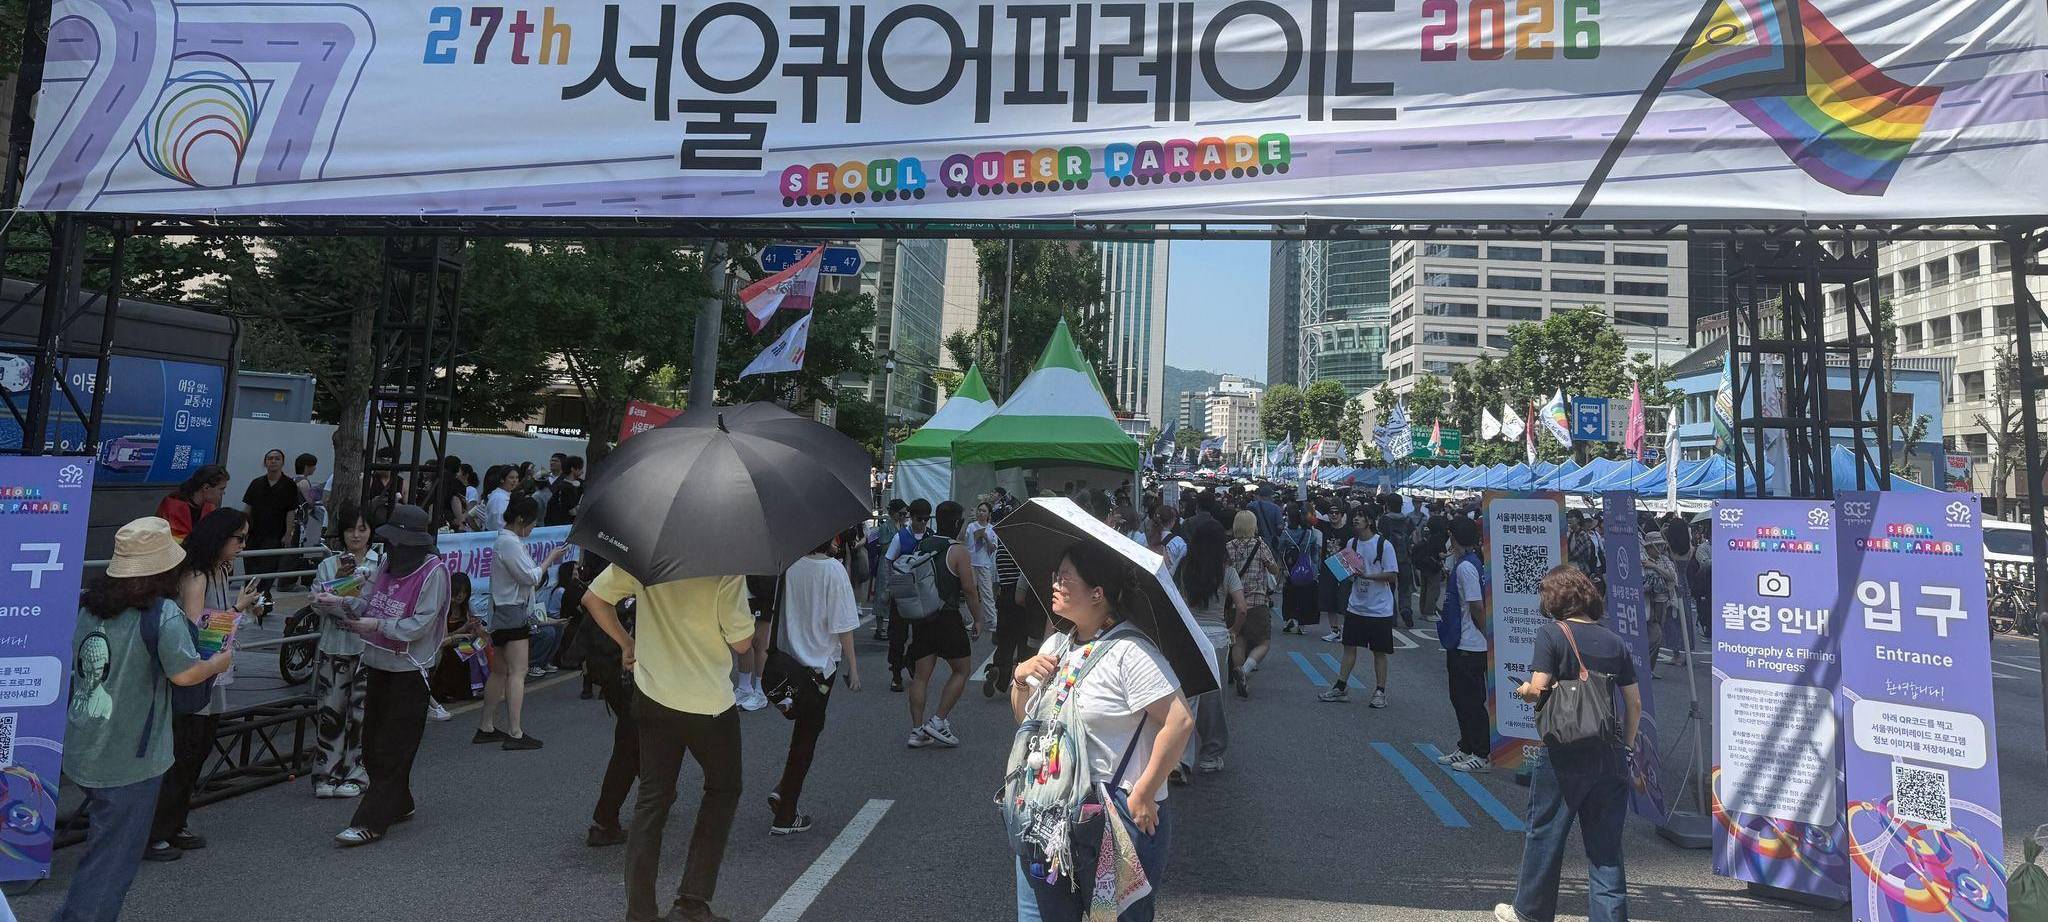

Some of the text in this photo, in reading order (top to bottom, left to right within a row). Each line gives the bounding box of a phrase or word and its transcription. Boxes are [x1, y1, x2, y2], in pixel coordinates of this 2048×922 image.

[424, 5, 572, 65] 27th
[1420, 0, 1601, 62] 2026
[561, 1, 1398, 171] 서울퀴어퍼레이드
[785, 137, 1284, 195] SEOUL QUEER PARADE
[765, 253, 777, 264] 41
[843, 257, 857, 268] 47
[178, 379, 196, 393] 여유
[12, 502, 69, 512] PARADE
[1518, 525, 1547, 535] 만들어요
[1757, 527, 1796, 537] SEOUL
[1887, 524, 1933, 536] SEOUL
[1728, 539, 1821, 552] QUEER PARADE
[1856, 538, 1962, 553] QUEER PARADE
[1617, 602, 1640, 637] 금연
[1721, 602, 1830, 637] 촬영 안내
[1718, 641, 1836, 664] Photography & Filming
[1875, 645, 1953, 668] Entrance
[1746, 657, 1806, 673] in Progress
[9, 678, 42, 687] 프로그램
[1885, 678, 1945, 701] 환영합니다!
[1882, 712, 1954, 731] 아래 QR코드를 찍고
[1871, 723, 1967, 746] 서울퀴어퍼레이드 프로그램
[1873, 736, 1966, 758] 정보 이미지를 저장하세요!
